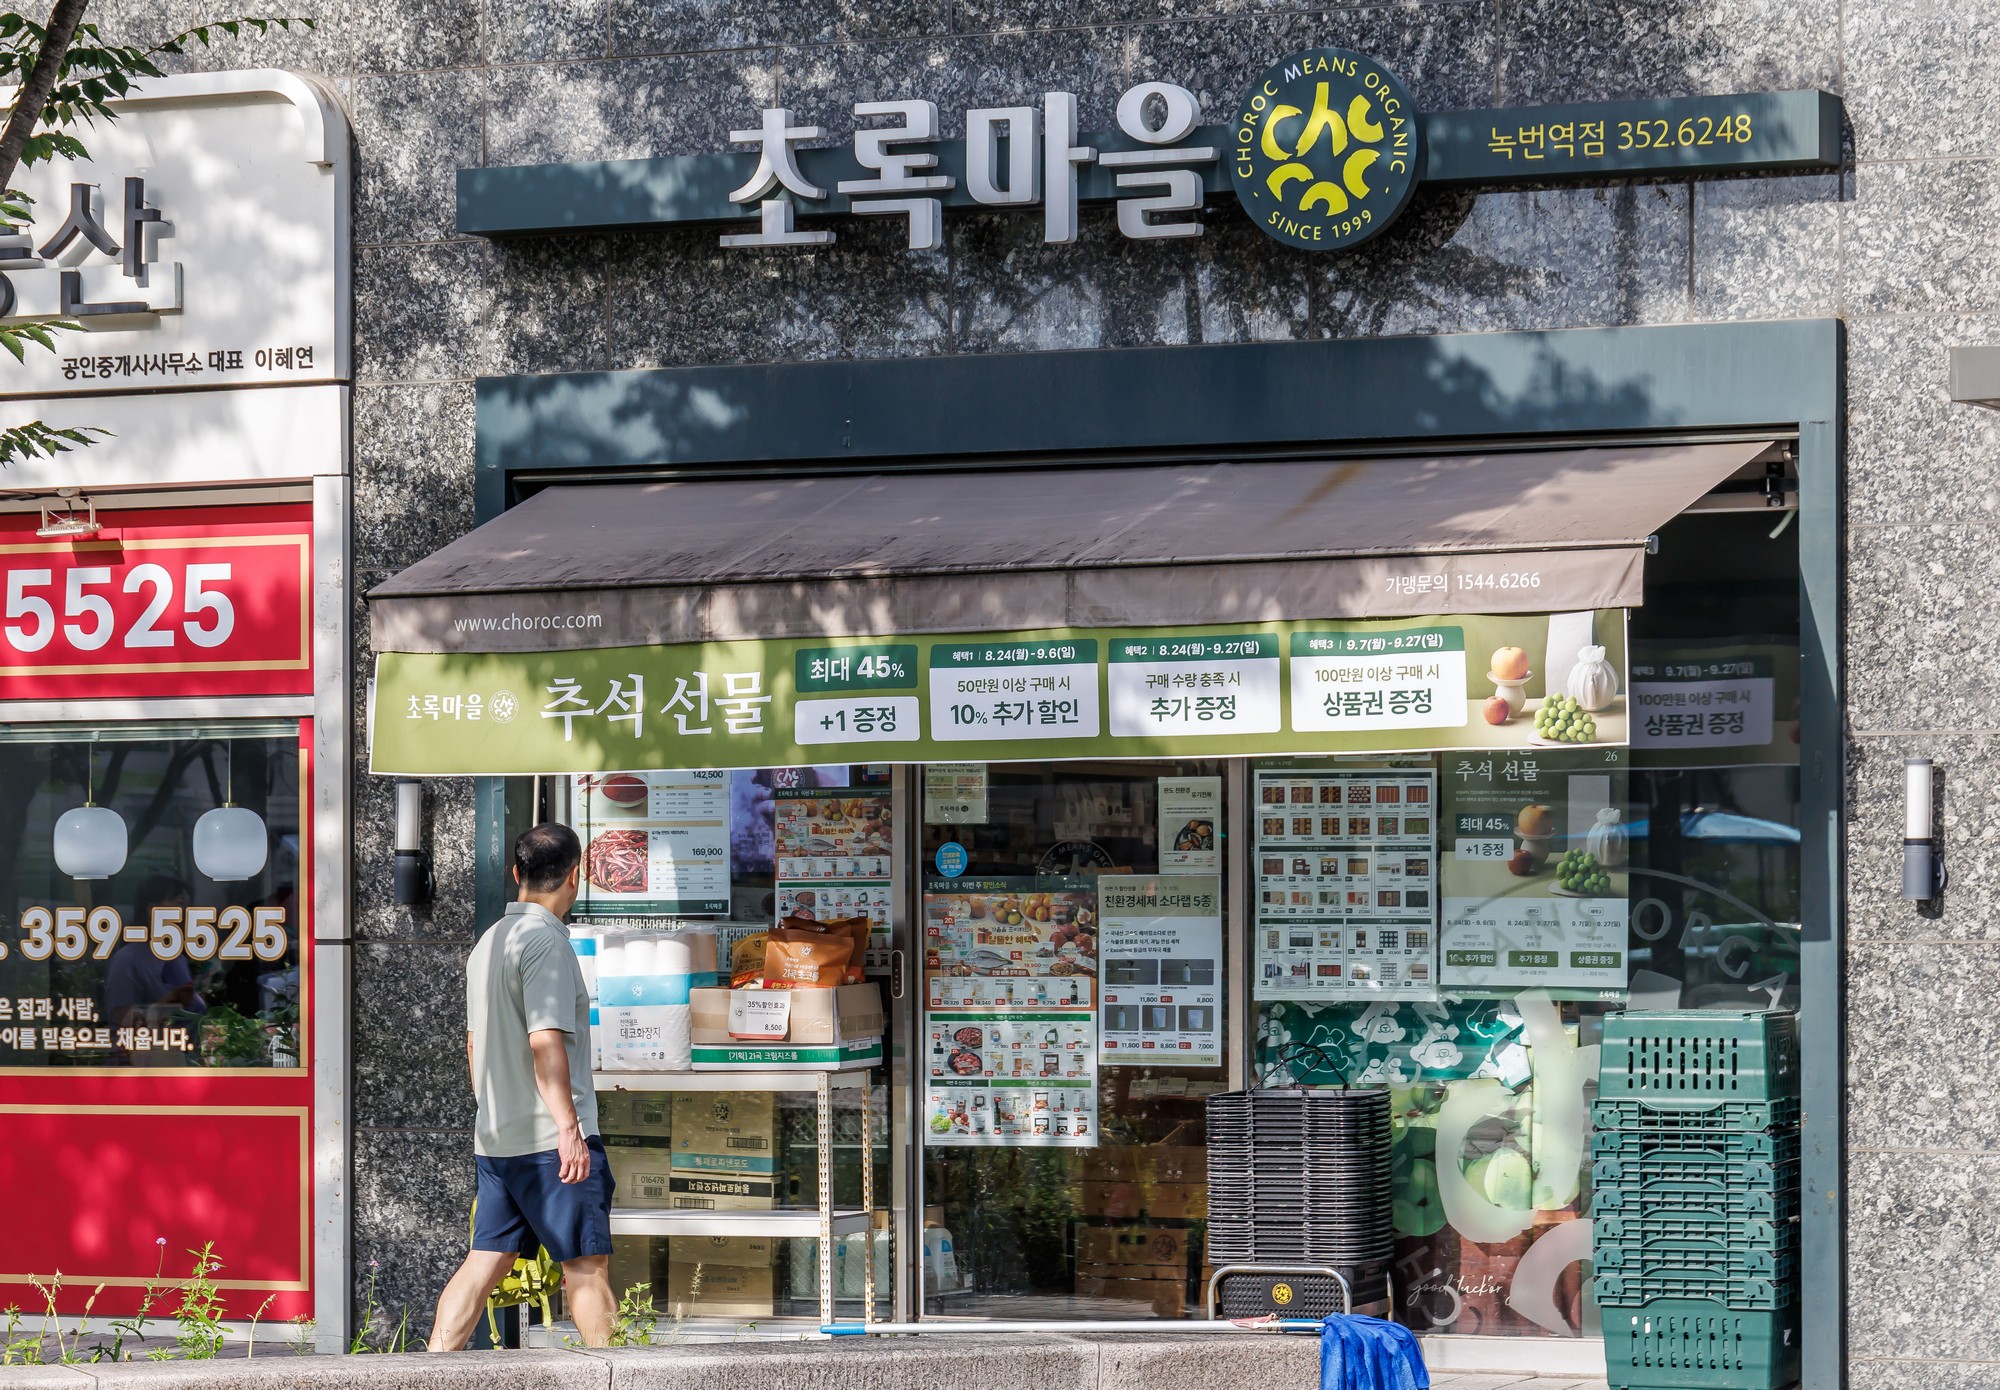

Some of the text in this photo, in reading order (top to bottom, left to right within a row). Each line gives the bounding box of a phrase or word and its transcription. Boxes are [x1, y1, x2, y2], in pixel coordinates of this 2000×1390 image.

[1236, 56, 1409, 179] CHOROC MEANS ORGANIC
[1487, 113, 1753, 160] 녹번역점 352.6248
[719, 81, 1221, 250] 초록마을
[1267, 208, 1373, 241] SINCE 1999
[60, 346, 314, 380] 공인중개사사무소 대표 이혜연
[1384, 571, 1542, 596] 가맹문의 1544.6266
[453, 611, 603, 633] www.choroc.com
[1124, 644, 1148, 656] 혜택2
[1308, 638, 1334, 651] 혜택3
[952, 650, 974, 662] 혜택1
[809, 655, 905, 683] 최대 45%
[1314, 663, 1440, 683] 100만원 이상 구매 시
[956, 674, 1071, 694] 50만원 이상 구매 시
[1144, 670, 1242, 690] 구매 수량 충족 시
[405, 693, 485, 722] 초록마을
[539, 672, 646, 743] 추석
[659, 670, 773, 736] 선물
[1322, 688, 1433, 718] 상품권 증정
[1636, 689, 1750, 707] 100만원 이상 구매 시
[949, 698, 1080, 727] 10% 추가 할인
[1149, 694, 1237, 723] 추가 증정
[819, 705, 898, 733] +1 증정
[1644, 710, 1745, 738] 상품권 증정
[692, 770, 724, 779] 142,500
[1455, 759, 1540, 782] 추석 선물
[1175, 787, 1191, 795] 친환경
[1460, 817, 1510, 831] 최대 45%
[691, 847, 723, 858] 169,900
[1465, 842, 1504, 857] +1 증정
[961, 881, 975, 890] 이번
[975, 881, 982, 890] 주
[1104, 894, 1212, 908] 친환경세제 소다랩 5종
[20, 905, 288, 961] 359-5525
[1464, 954, 1494, 963] 추가 할인
[1518, 954, 1548, 964] 추가 증정
[1577, 955, 1614, 965] 상품권 증정
[17, 997, 54, 1021] 집과
[56, 997, 100, 1023] 사람,
[41, 1026, 113, 1050] 믿음으로
[116, 1026, 195, 1051] 채웁니다.
[620, 1026, 661, 1040] 데코화장지
[1159, 1042, 1177, 1050] 8,800
[748, 1051, 763, 1061] 21곡
[763, 1051, 799, 1062] 크림치즈롤
[640, 1175, 665, 1184] 016478
